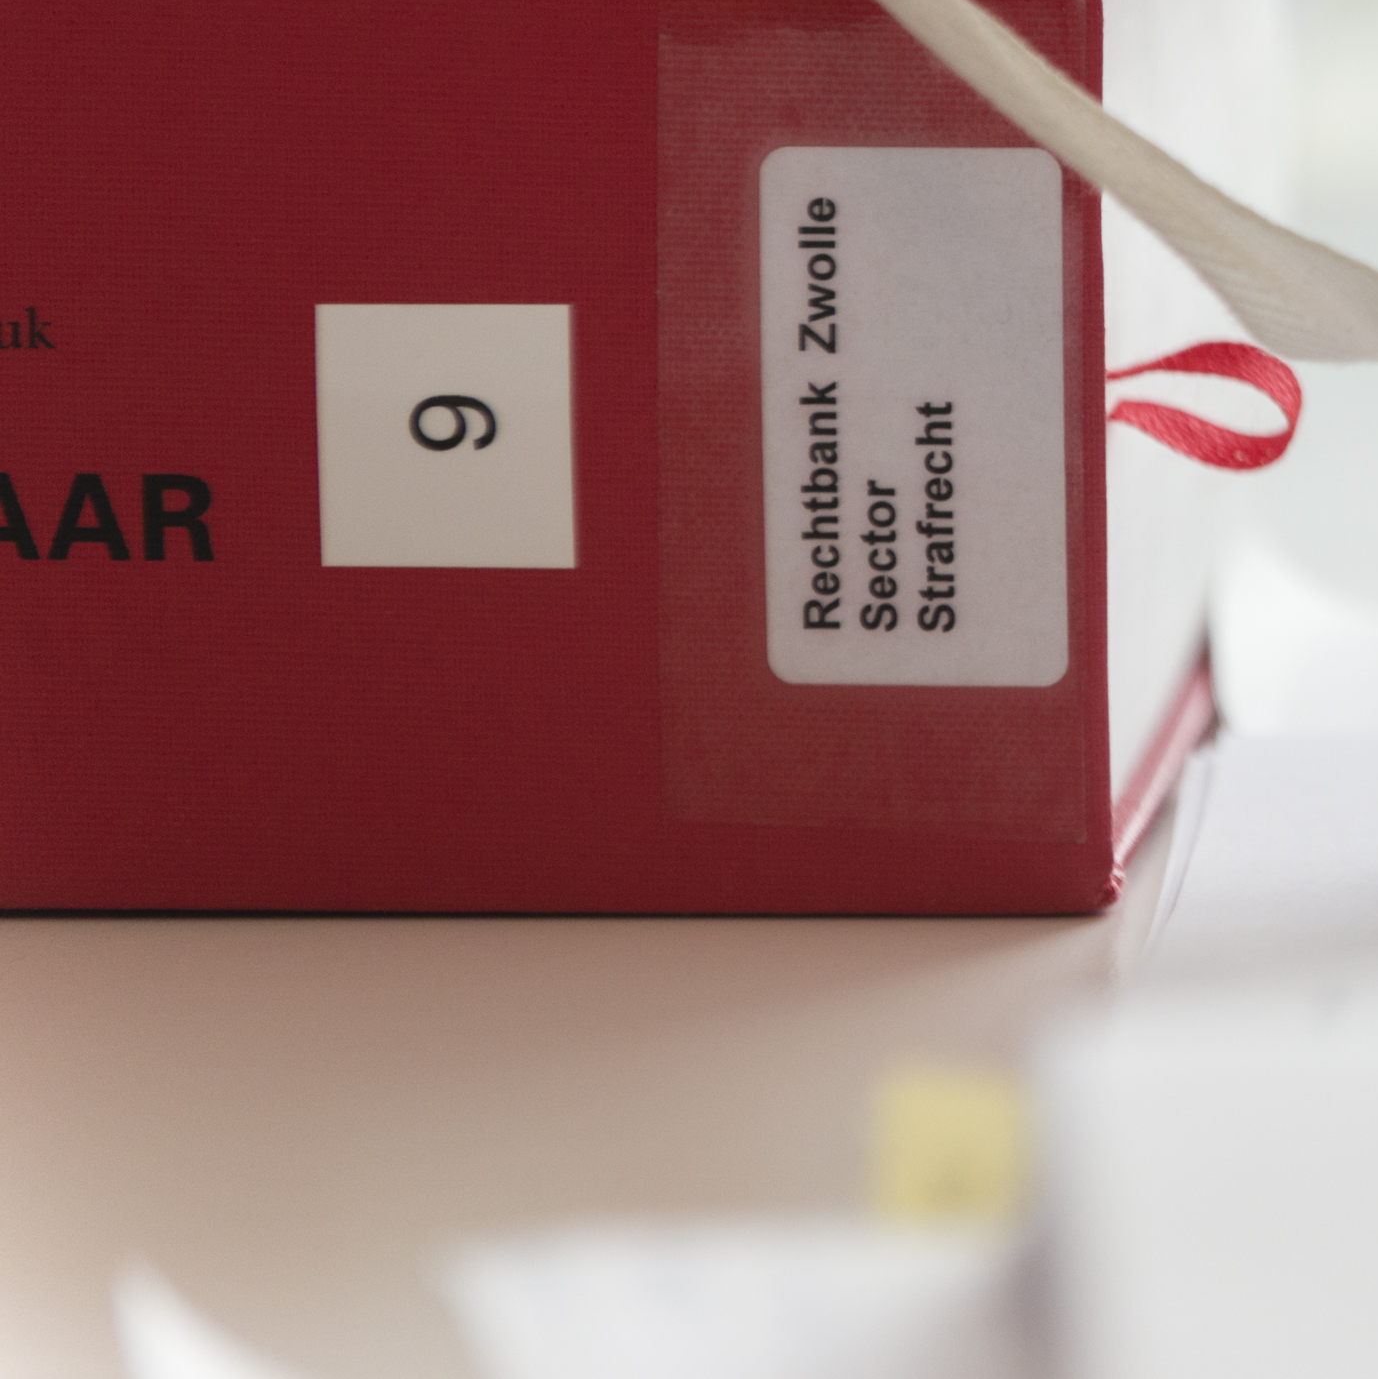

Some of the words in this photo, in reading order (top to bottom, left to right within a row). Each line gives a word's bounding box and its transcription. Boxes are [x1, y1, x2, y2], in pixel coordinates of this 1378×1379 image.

[797, 196, 838, 355] Zwolle
[799, 380, 842, 630] Rechtbank
[859, 479, 900, 633] Sector
[914, 400, 957, 634] Strafrecht
